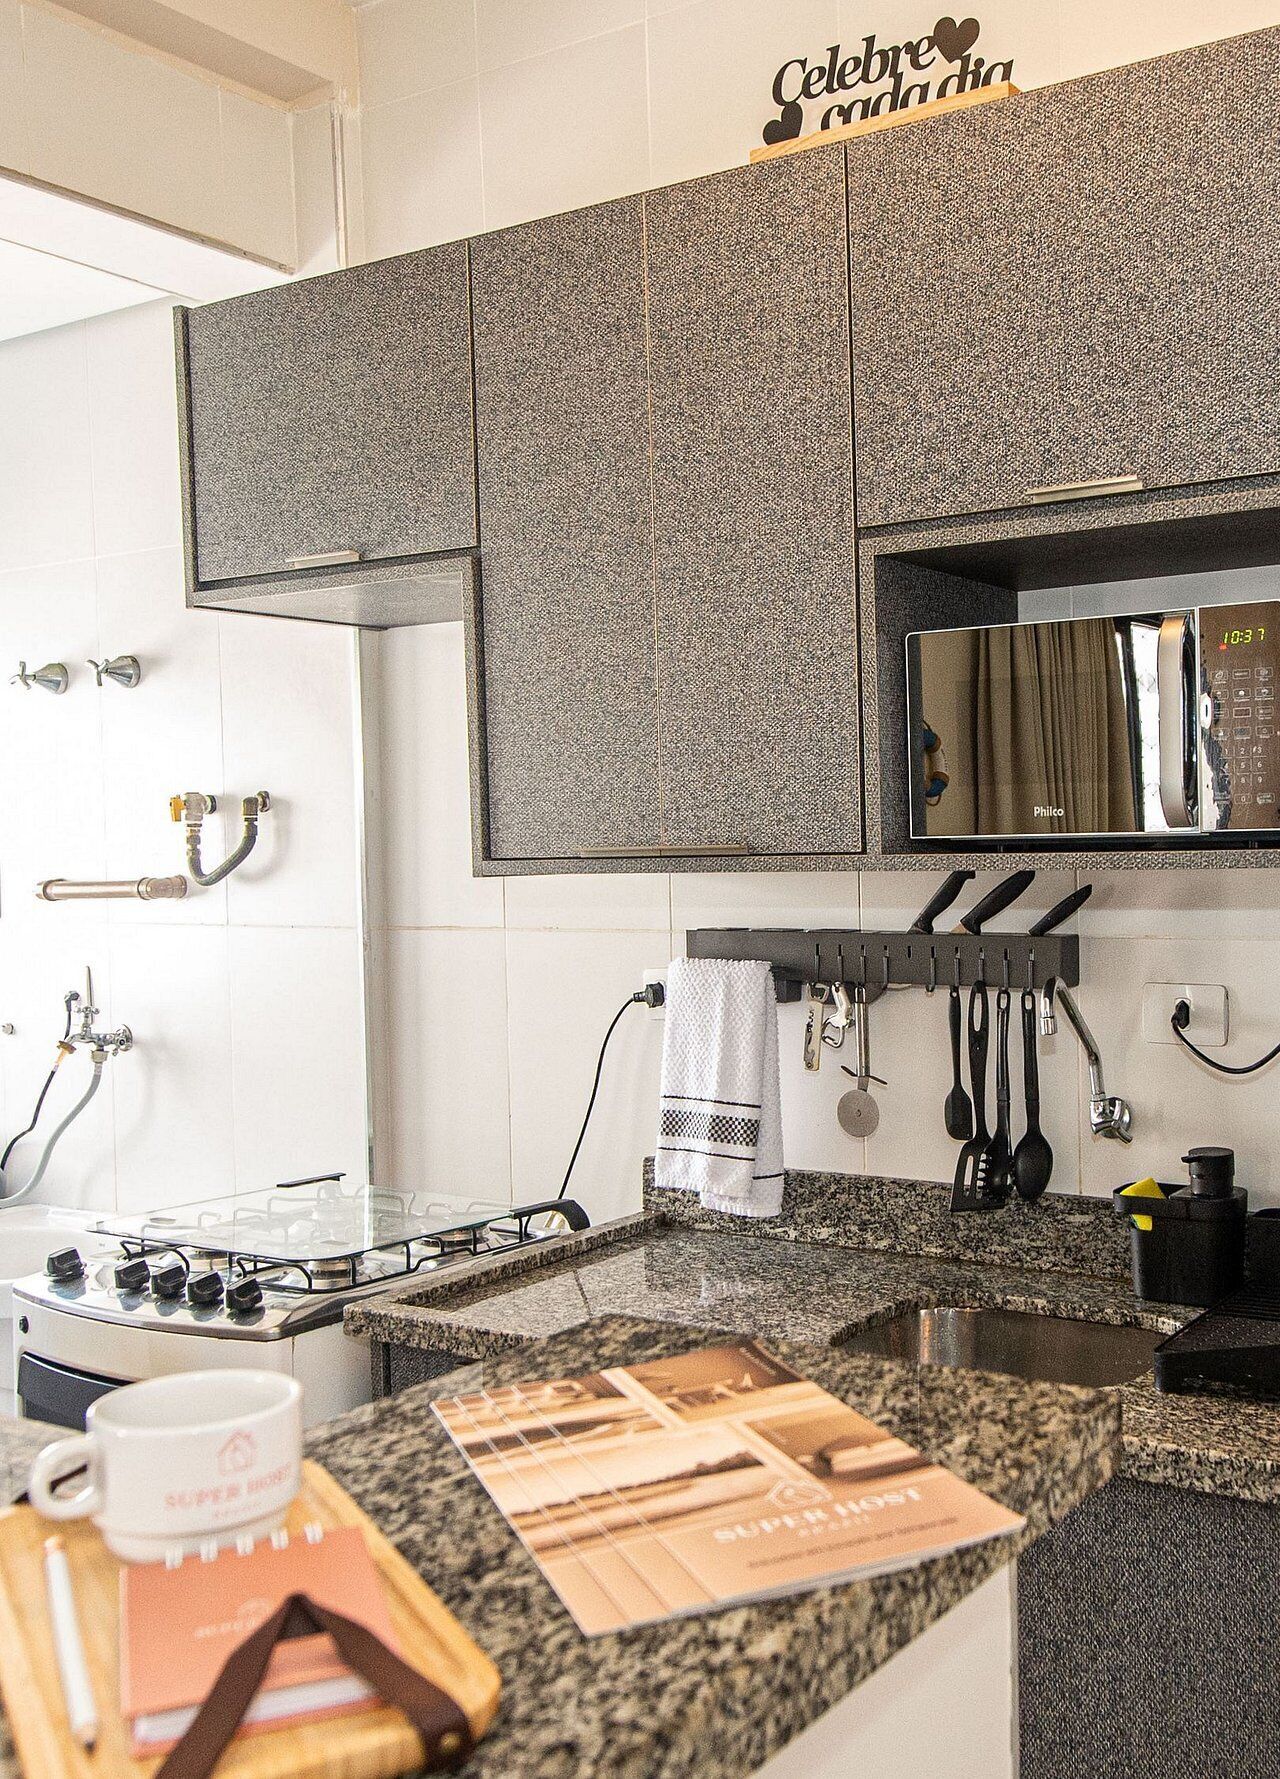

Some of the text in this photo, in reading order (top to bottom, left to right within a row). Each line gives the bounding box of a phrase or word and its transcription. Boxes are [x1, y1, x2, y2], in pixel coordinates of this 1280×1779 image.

[772, 34, 936, 106] Celebre
[1223, 628, 1266, 645] 10:37
[1033, 806, 1065, 817] Philco
[713, 1509, 829, 1544] SUPER
[833, 1486, 922, 1518] HOST
